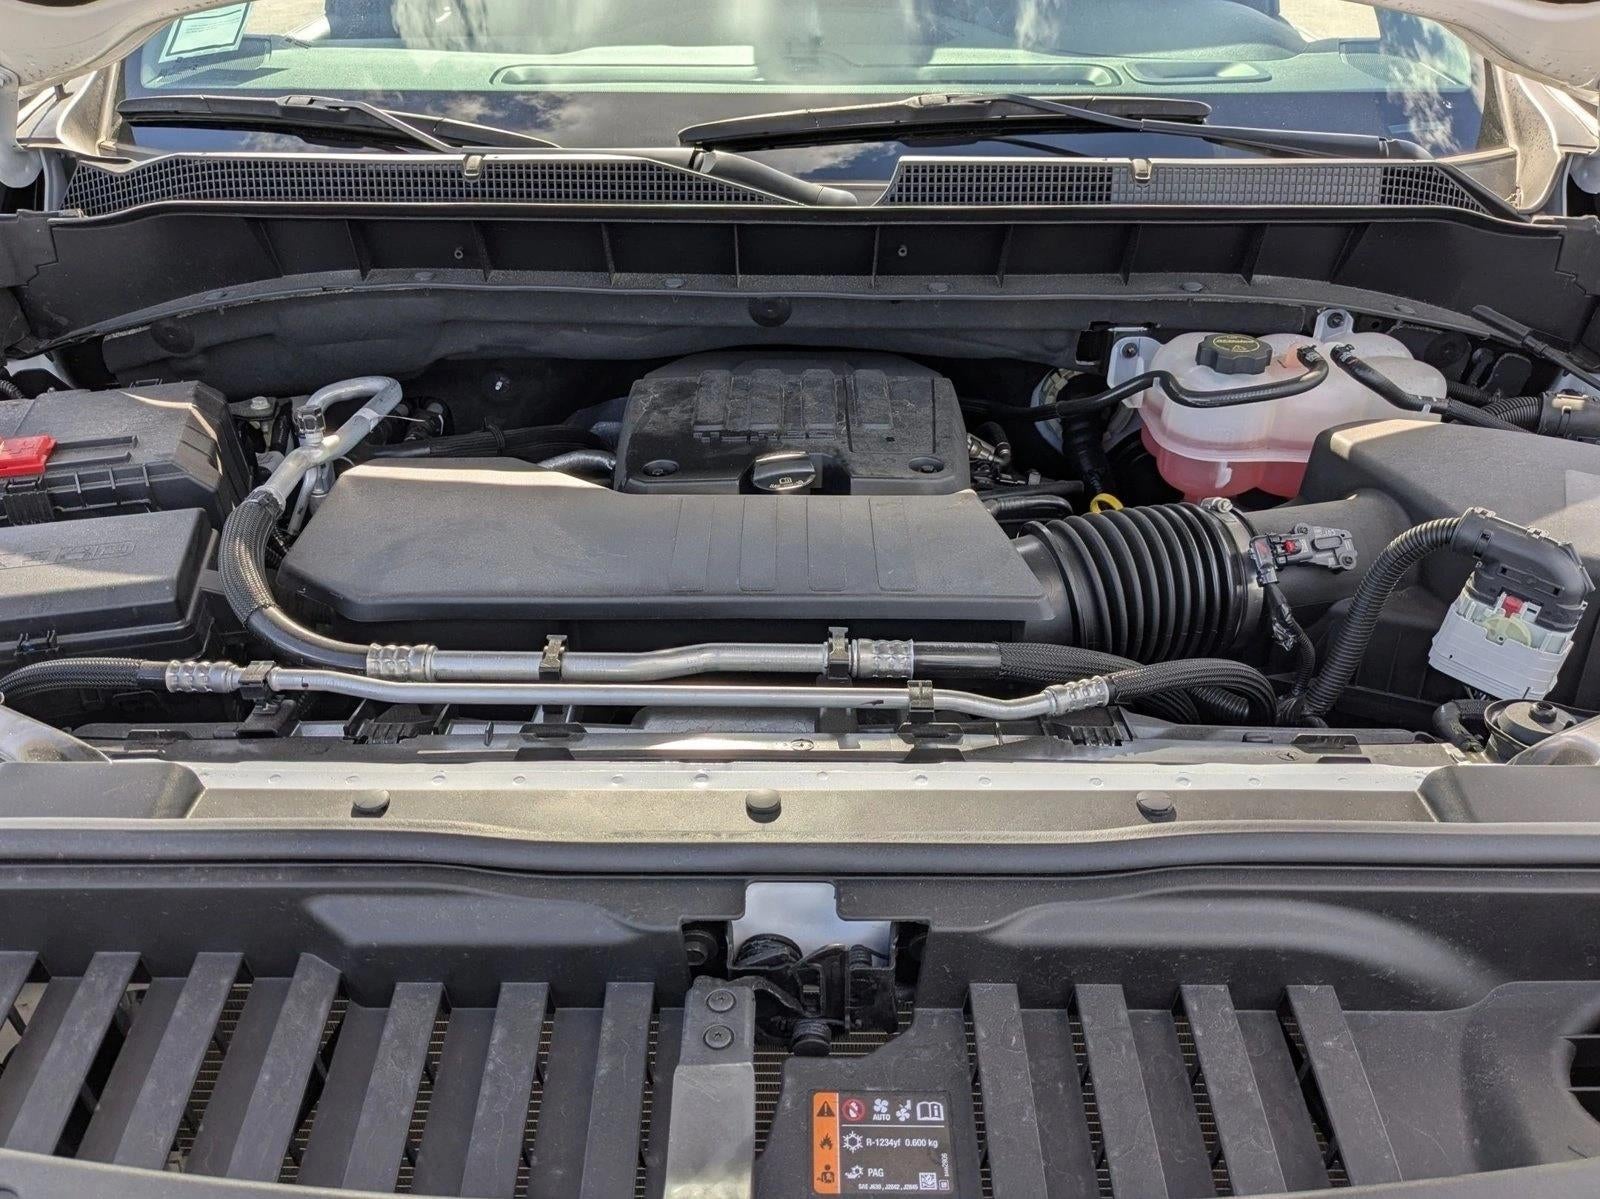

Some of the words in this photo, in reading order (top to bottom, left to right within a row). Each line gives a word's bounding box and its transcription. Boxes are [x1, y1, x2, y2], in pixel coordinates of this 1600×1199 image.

[872, 1113, 891, 1121] AUTO
[866, 1138, 901, 1148] R-1234yf
[904, 1138, 927, 1147] 0.600
[928, 1138, 938, 1149] kg
[867, 1167, 884, 1177] PAG
